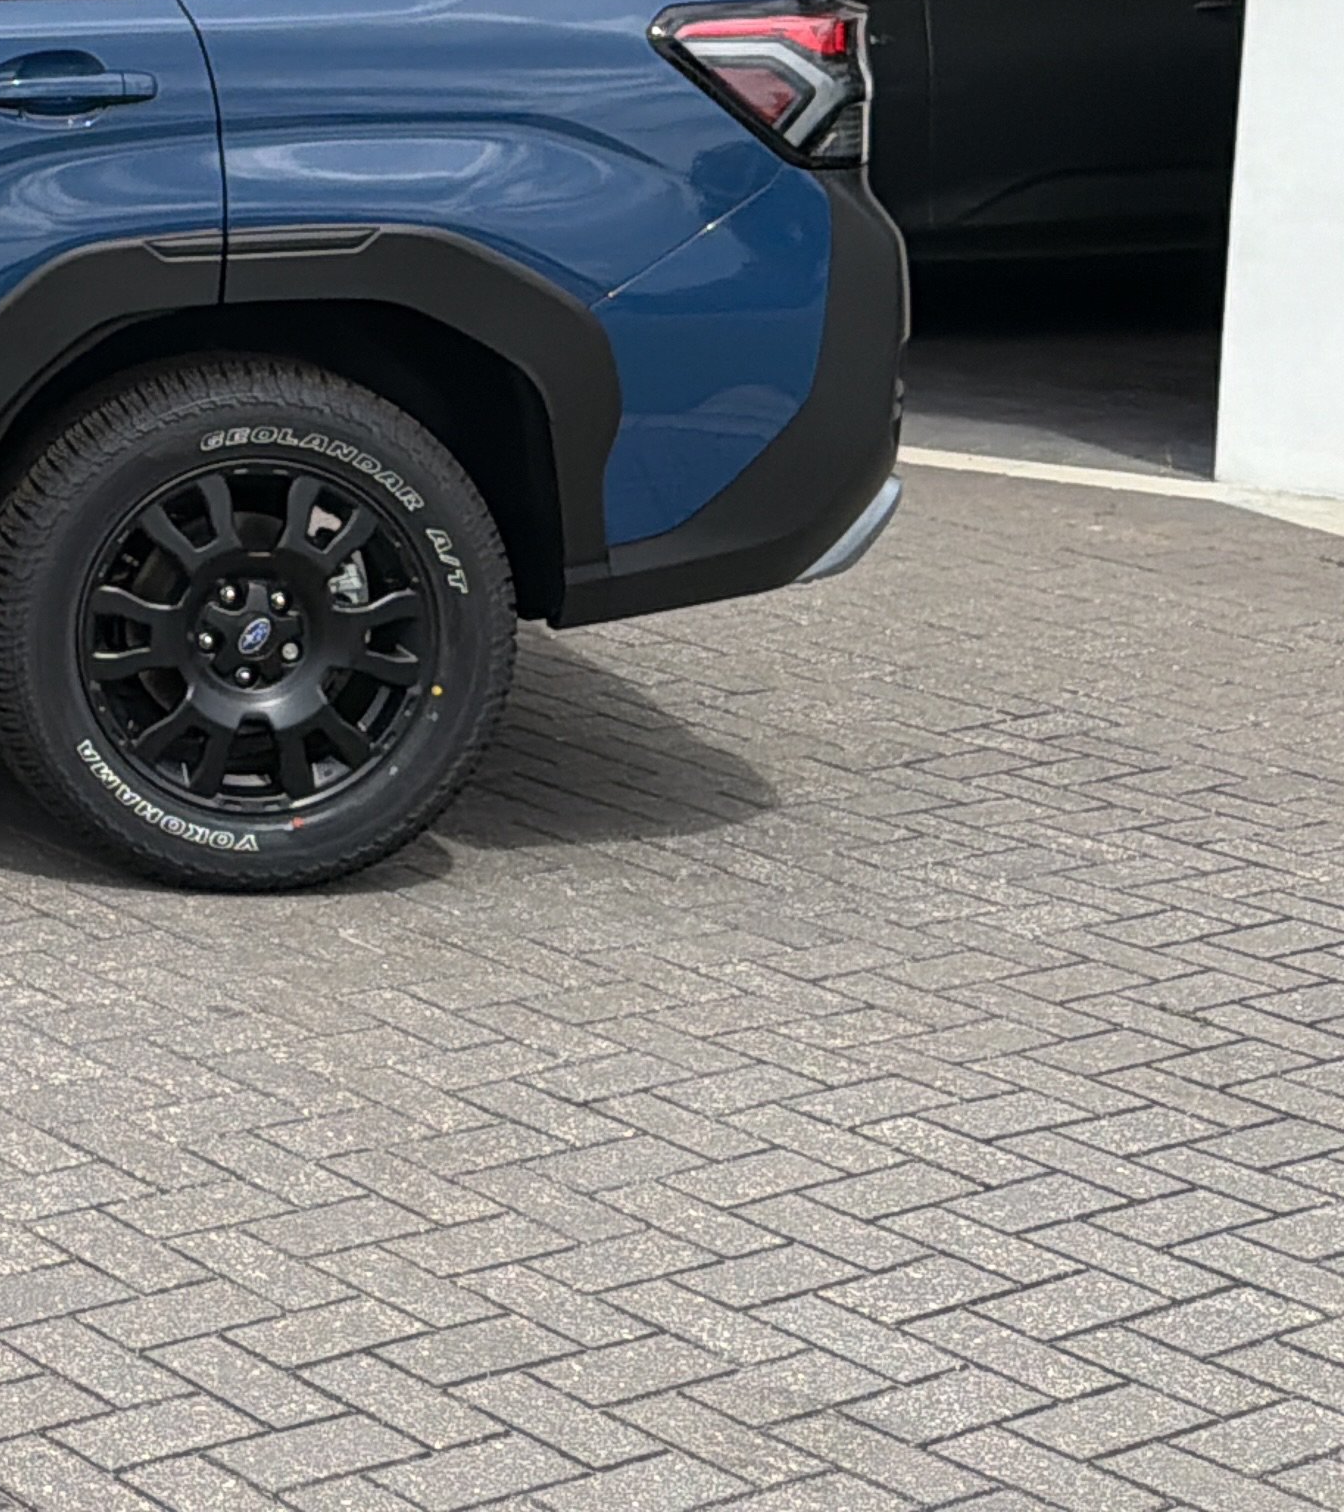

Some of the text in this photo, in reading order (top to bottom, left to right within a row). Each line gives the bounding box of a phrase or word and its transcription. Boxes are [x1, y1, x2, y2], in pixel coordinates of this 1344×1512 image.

[200, 426, 468, 594] GEOLANDAR A/T
[76, 739, 259, 852] YOKOHAMA
